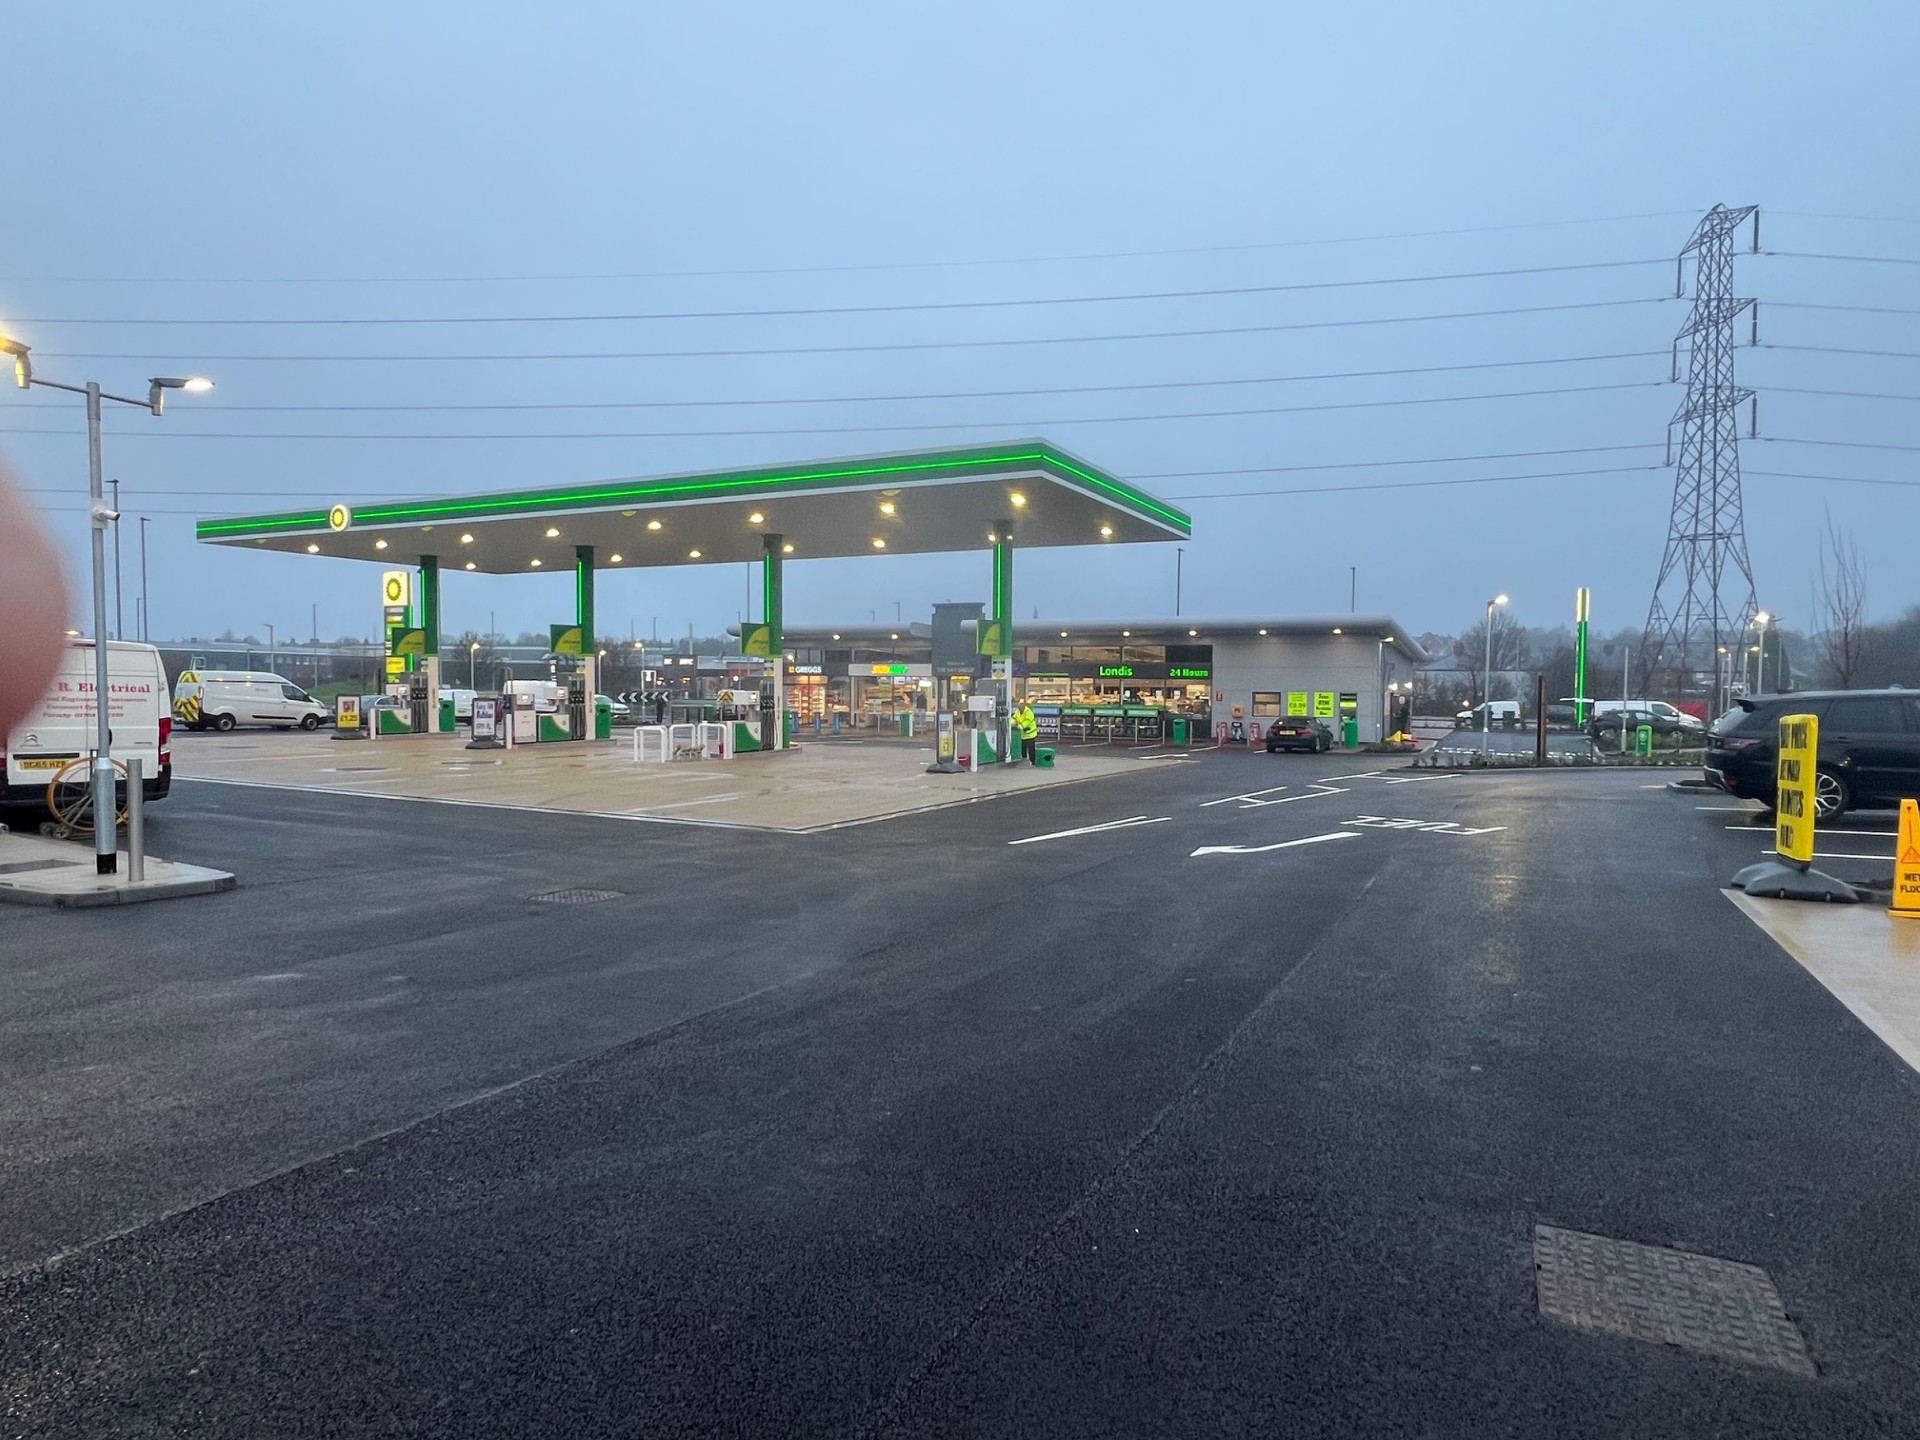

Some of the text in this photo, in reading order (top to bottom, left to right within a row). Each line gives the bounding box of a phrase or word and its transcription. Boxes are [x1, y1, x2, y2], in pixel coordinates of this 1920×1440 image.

[795, 665, 823, 674] GREGGS
[1099, 665, 1133, 677] Londis
[1169, 668, 1209, 677] 24 Hours
[78, 682, 151, 694] Eltrical
